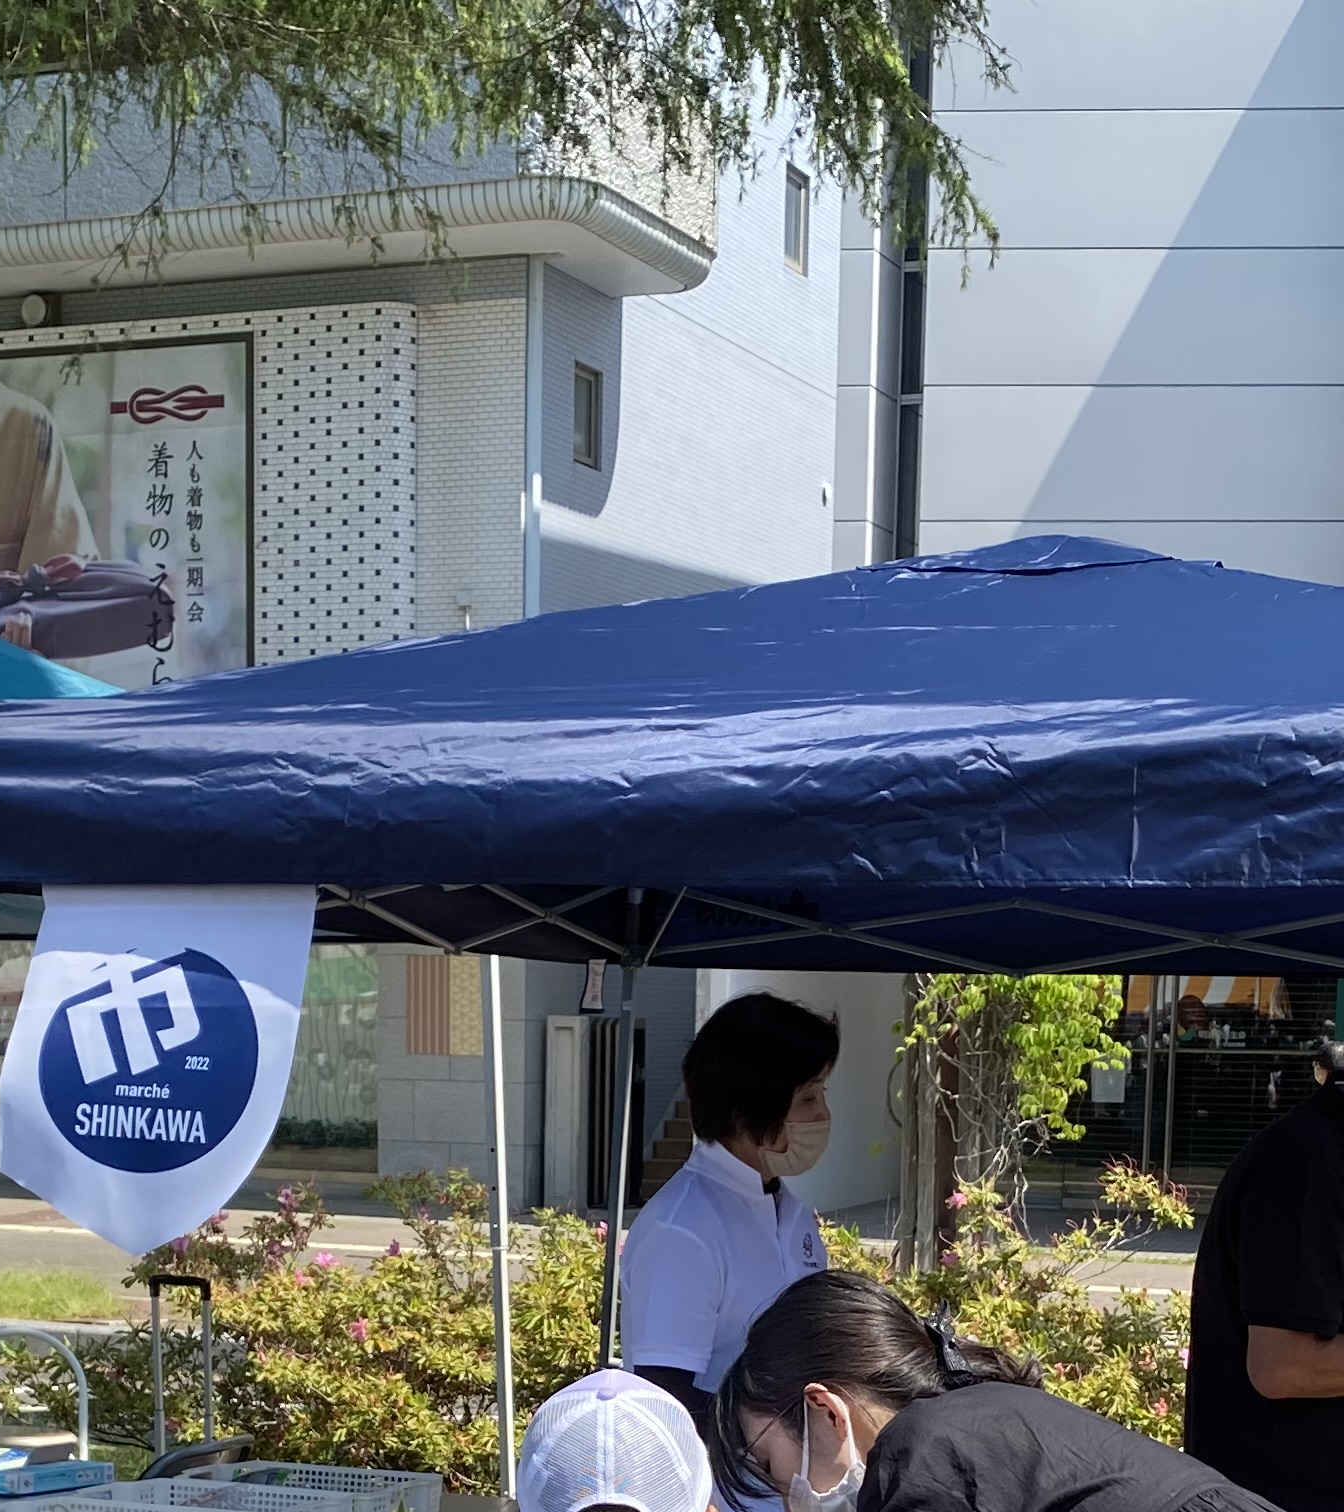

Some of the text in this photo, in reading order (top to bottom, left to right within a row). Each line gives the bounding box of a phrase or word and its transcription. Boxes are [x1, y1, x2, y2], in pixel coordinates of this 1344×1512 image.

[186, 440, 204, 623] 人も着物も一期一会
[184, 1055, 210, 1071] 2022
[114, 1083, 171, 1099] marché
[74, 1102, 207, 1145] SHINKAWA
